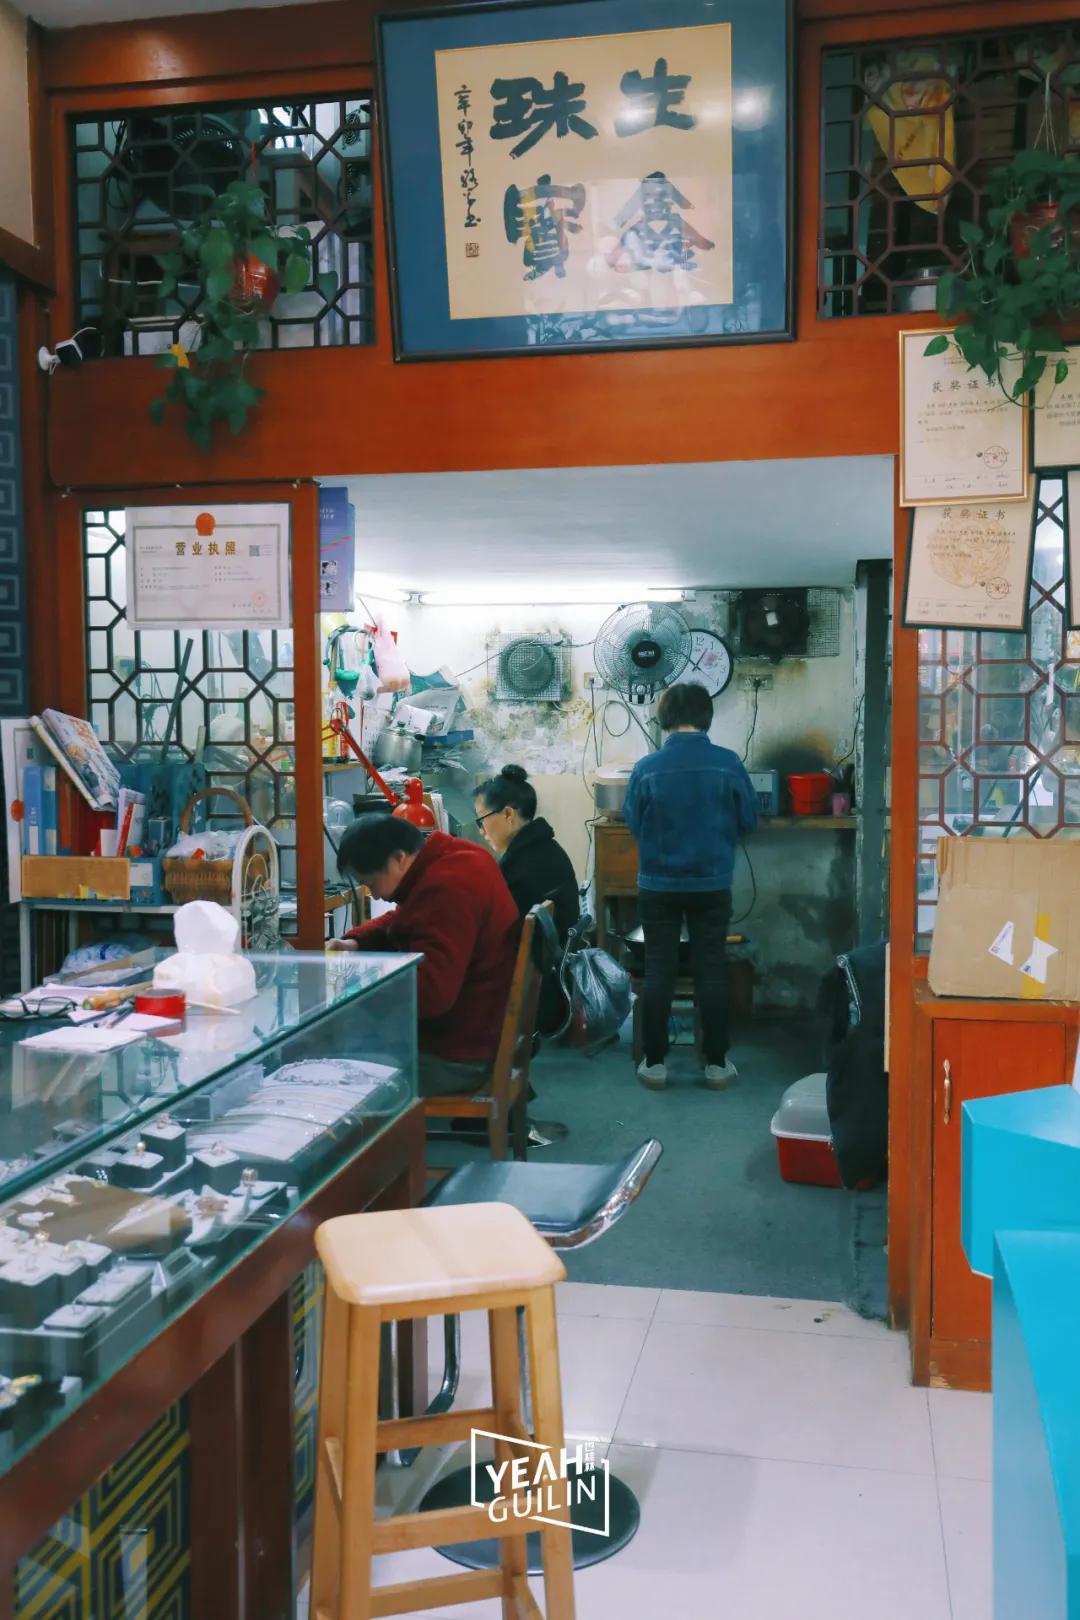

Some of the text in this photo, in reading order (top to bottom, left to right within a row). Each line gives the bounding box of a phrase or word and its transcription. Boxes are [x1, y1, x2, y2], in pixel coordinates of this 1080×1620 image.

[175, 541, 236, 556] 营业执照
[696, 636, 705, 646] 12
